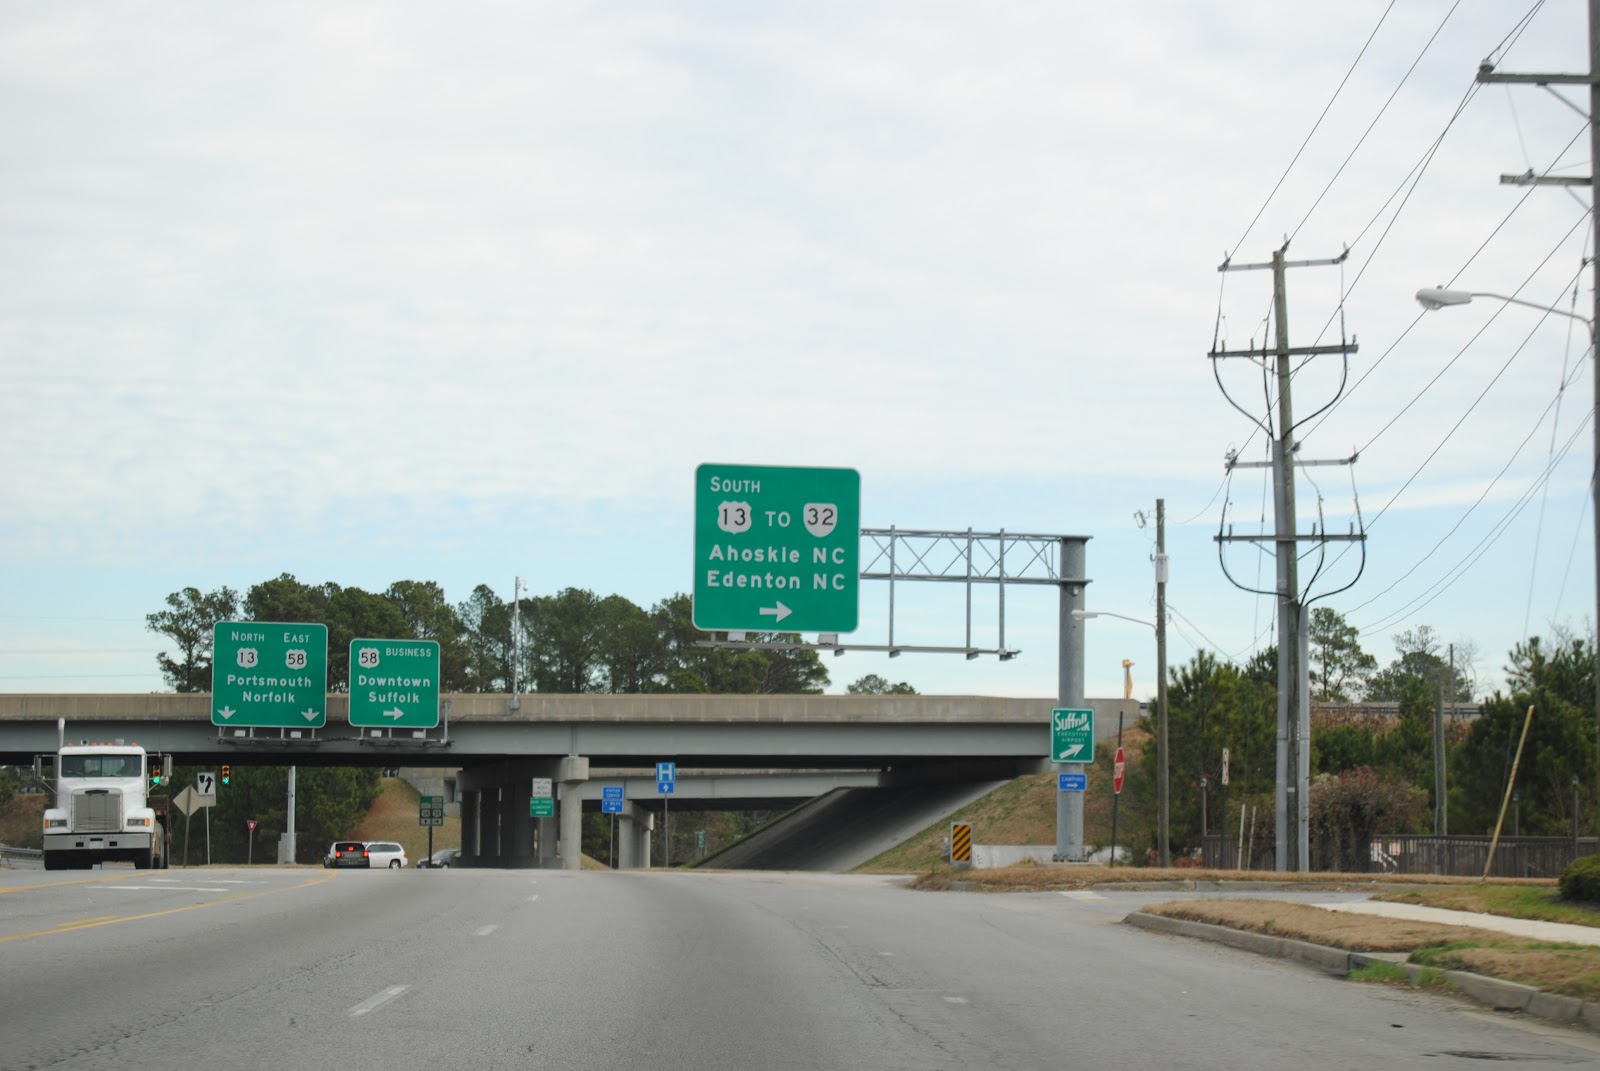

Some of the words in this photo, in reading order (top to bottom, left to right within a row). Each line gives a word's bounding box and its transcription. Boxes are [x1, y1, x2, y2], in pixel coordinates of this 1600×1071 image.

[710, 476, 760, 493] SOUTH
[722, 508, 746, 526] 13
[765, 511, 791, 527] TO
[807, 508, 834, 526] 32
[709, 544, 800, 563] Ahoskie
[707, 570, 800, 589] Edenton
[231, 631, 265, 642] NORTH
[284, 632, 310, 643] EAST
[239, 652, 255, 663] 13
[288, 653, 304, 665] 58
[361, 652, 378, 663] 58
[385, 648, 432, 657] BUSINESS
[227, 674, 312, 687] Portsmouth
[358, 675, 430, 687] Downtown
[242, 691, 295, 703] Norfolk
[368, 691, 420, 703] Suffolk
[1054, 712, 1090, 731] Suffolk
